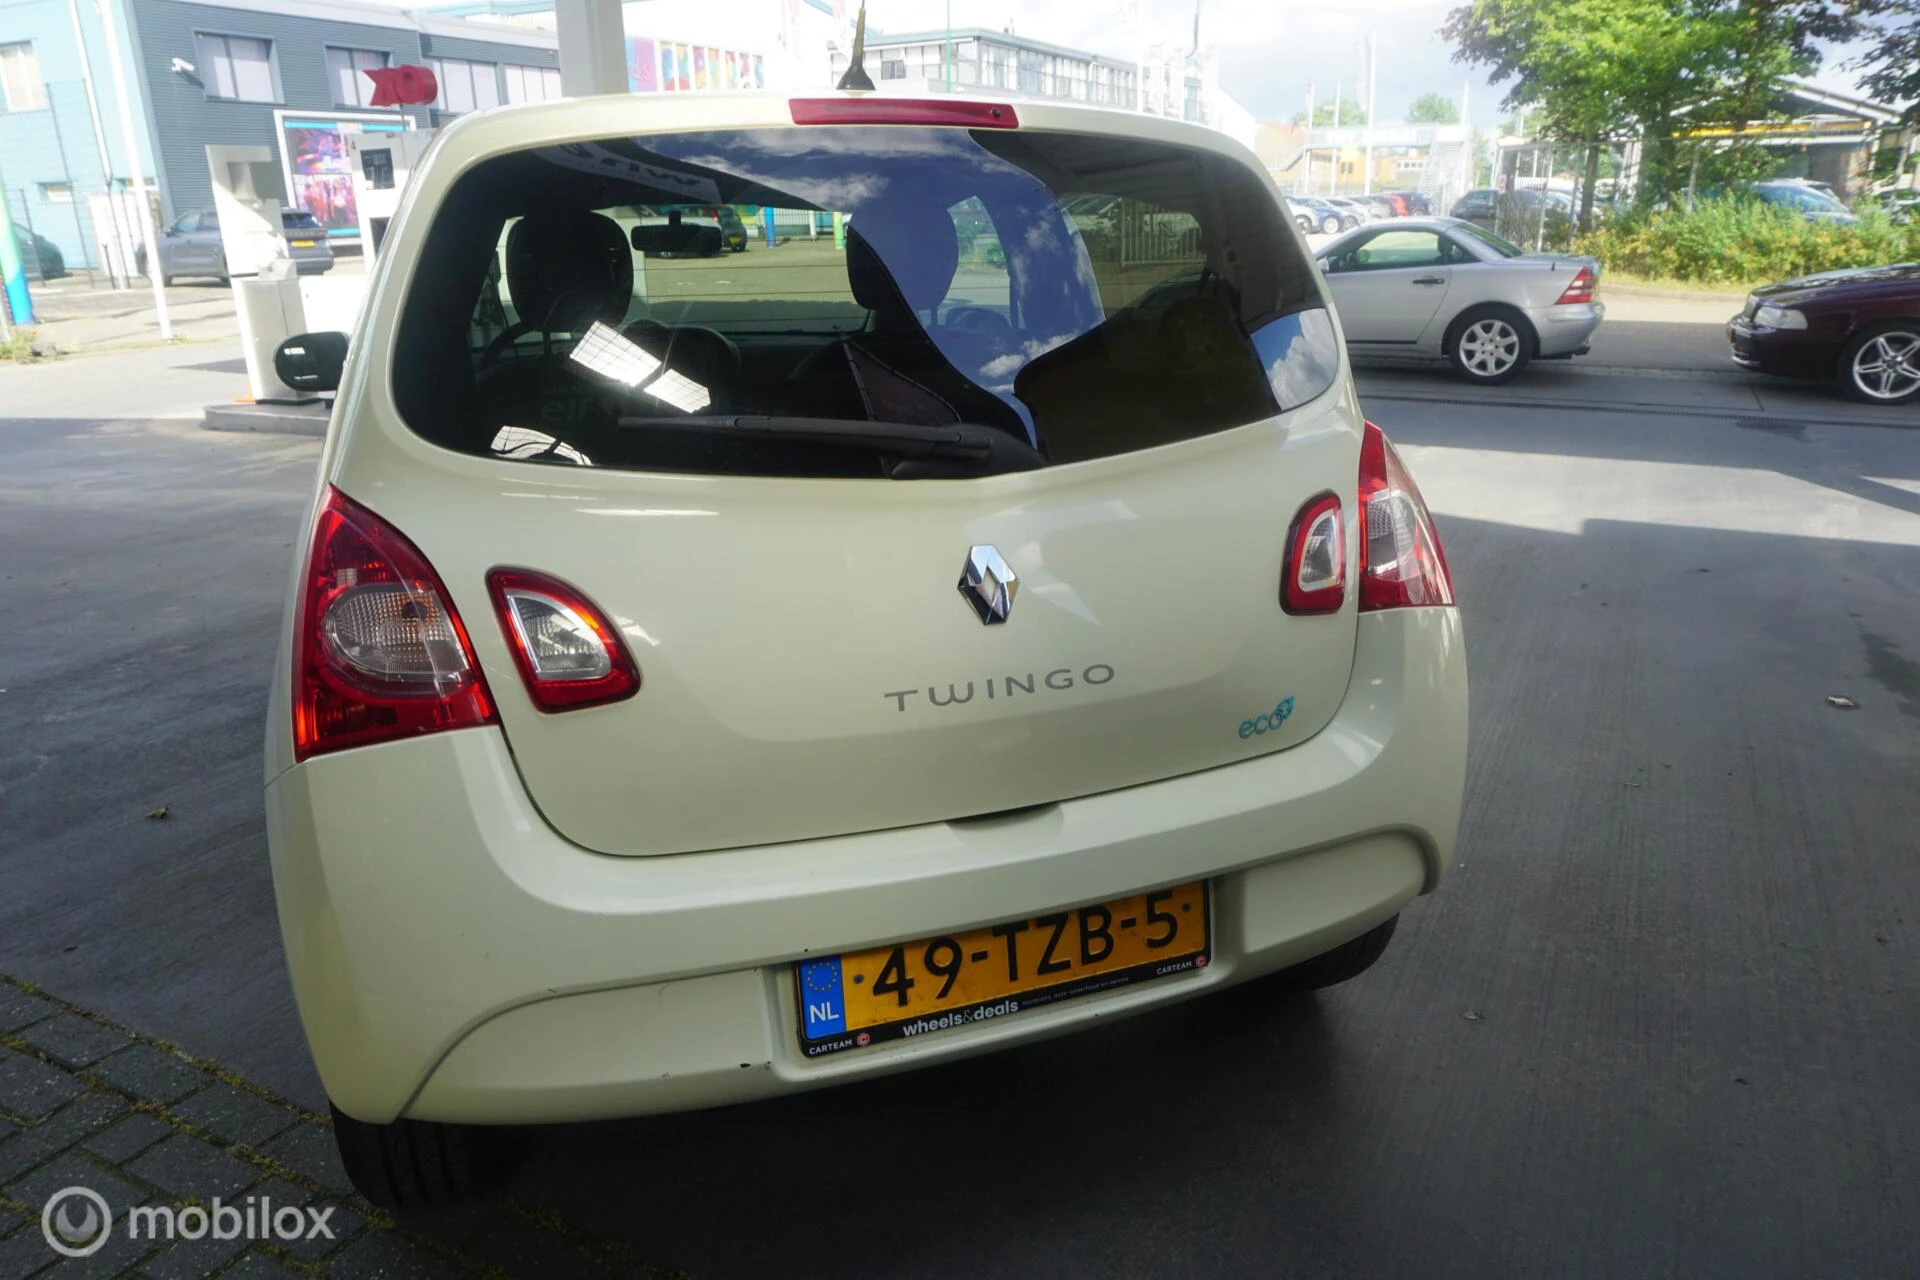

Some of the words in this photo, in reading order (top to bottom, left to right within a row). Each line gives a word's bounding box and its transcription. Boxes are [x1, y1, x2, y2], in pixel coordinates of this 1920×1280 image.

[884, 664, 1115, 712] TWINGO
[873, 889, 1178, 1007] 49-TZB-5
[1156, 961, 1193, 975] CARTEAM
[810, 1001, 839, 1024] NL
[903, 1000, 1019, 1037] wheels&deals
[809, 1039, 852, 1055] CARTEAM
